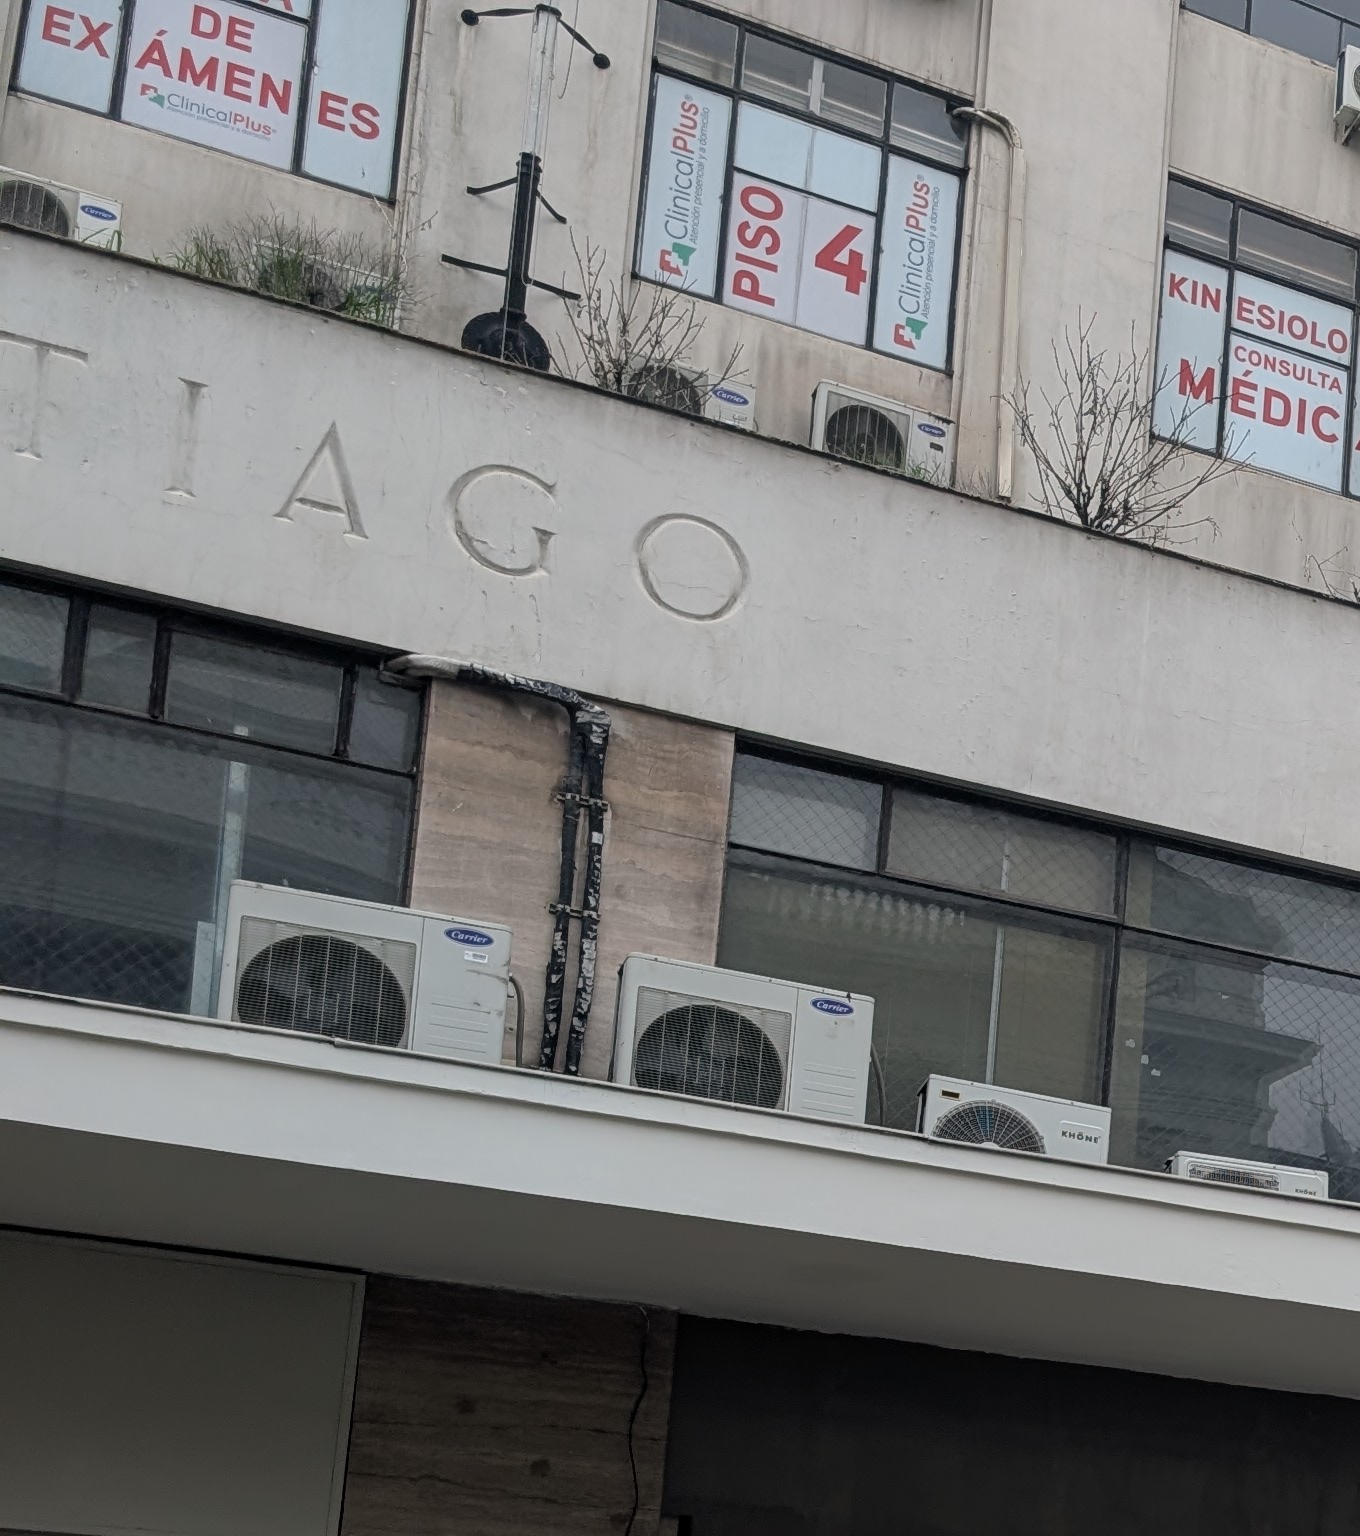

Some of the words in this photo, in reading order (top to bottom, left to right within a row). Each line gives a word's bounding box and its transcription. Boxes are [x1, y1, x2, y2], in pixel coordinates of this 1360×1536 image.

[190, 4, 255, 53] DE
[732, 186, 784, 307] PISO
[815, 224, 867, 296] 4
[1234, 345, 1343, 395] CONSULTA
[716, 390, 745, 403] Carrier
[451, 930, 488, 943] Carrier
[816, 1001, 849, 1013] Carrier
